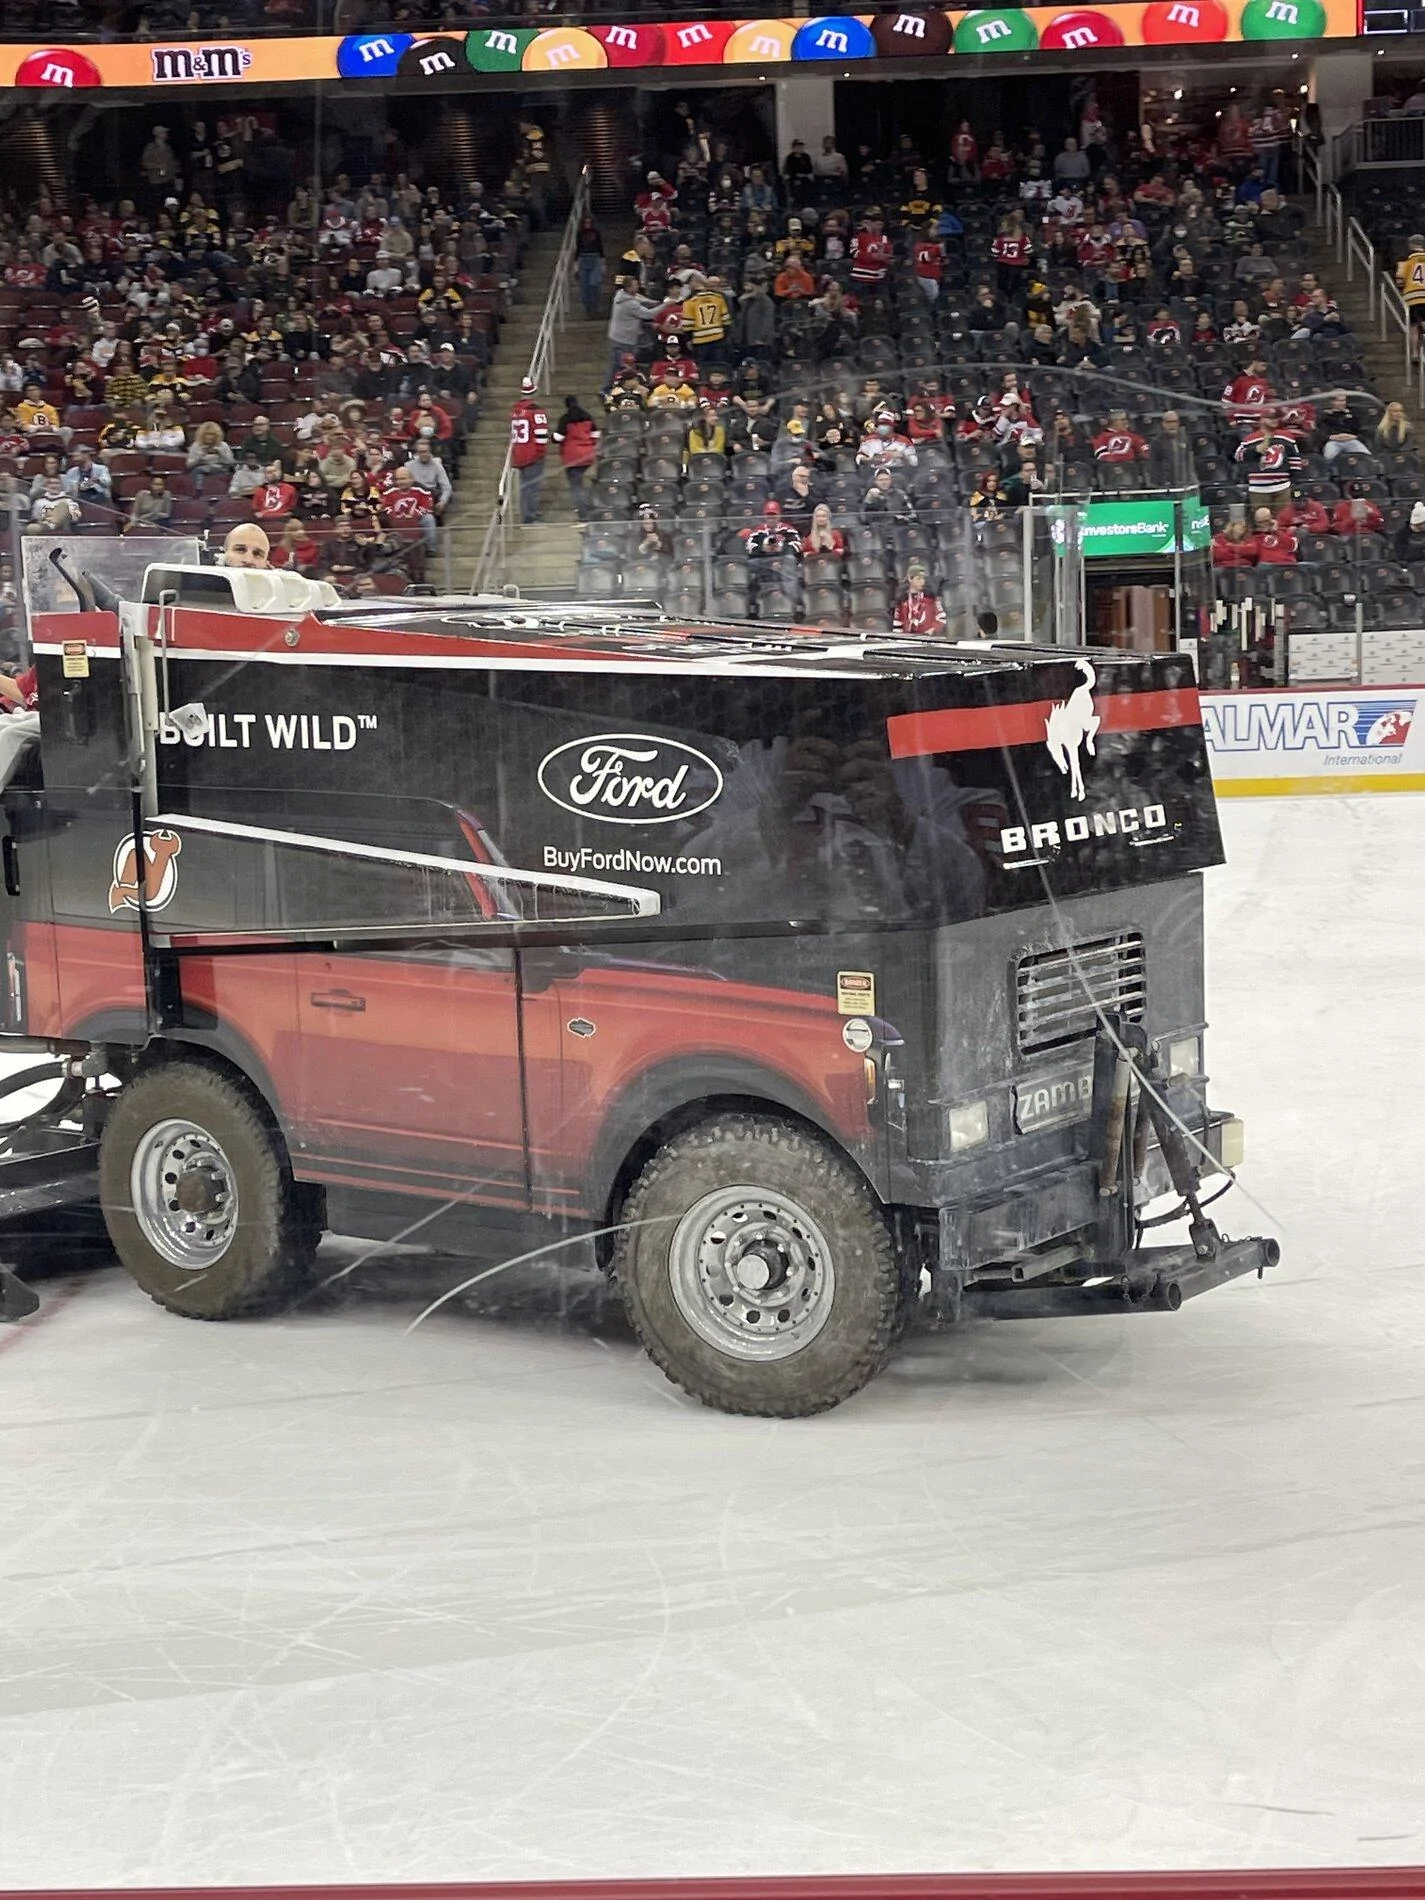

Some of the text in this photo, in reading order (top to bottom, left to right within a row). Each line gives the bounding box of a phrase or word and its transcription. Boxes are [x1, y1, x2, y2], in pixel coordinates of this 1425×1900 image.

[699, 305, 718, 325] 17
[1324, 752, 1403, 767] International
[569, 745, 690, 810] Ford
[1000, 804, 1167, 854] BRONCO
[543, 845, 722, 876] BuyFordNow.com
